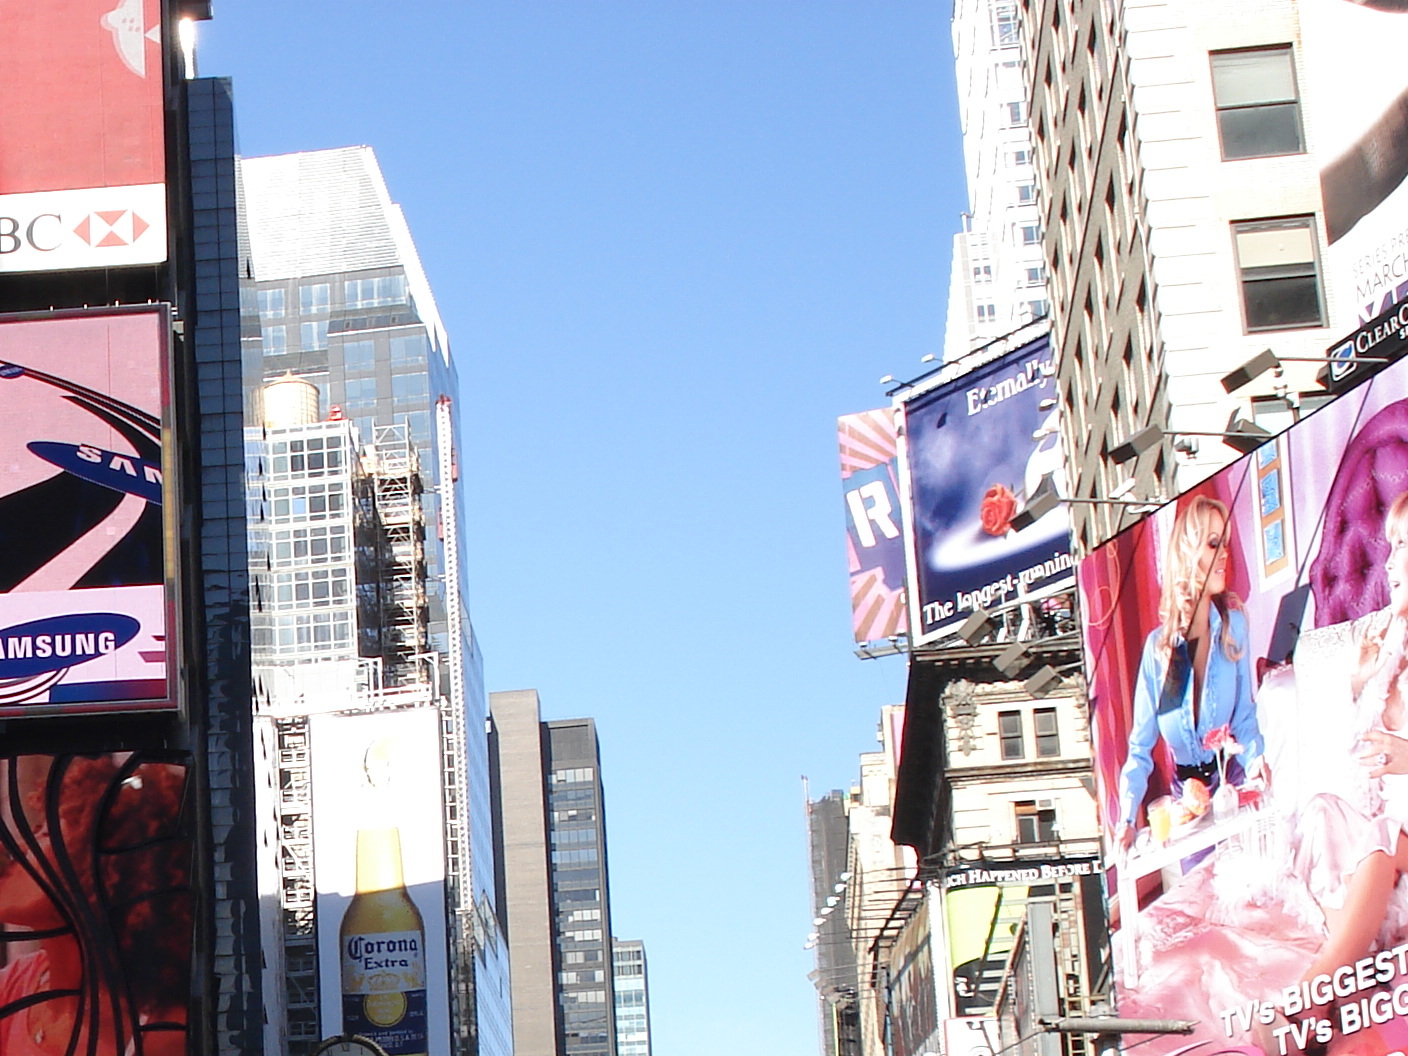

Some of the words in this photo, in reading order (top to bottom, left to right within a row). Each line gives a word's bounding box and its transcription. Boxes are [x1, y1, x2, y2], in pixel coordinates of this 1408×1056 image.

[922, 600, 955, 626] The
[968, 868, 1039, 884] HAPPENED
[347, 936, 419, 962] Corona
[363, 957, 409, 971] Extra
[1220, 999, 1276, 1038] TV's
[1272, 1019, 1333, 1056] TV's
